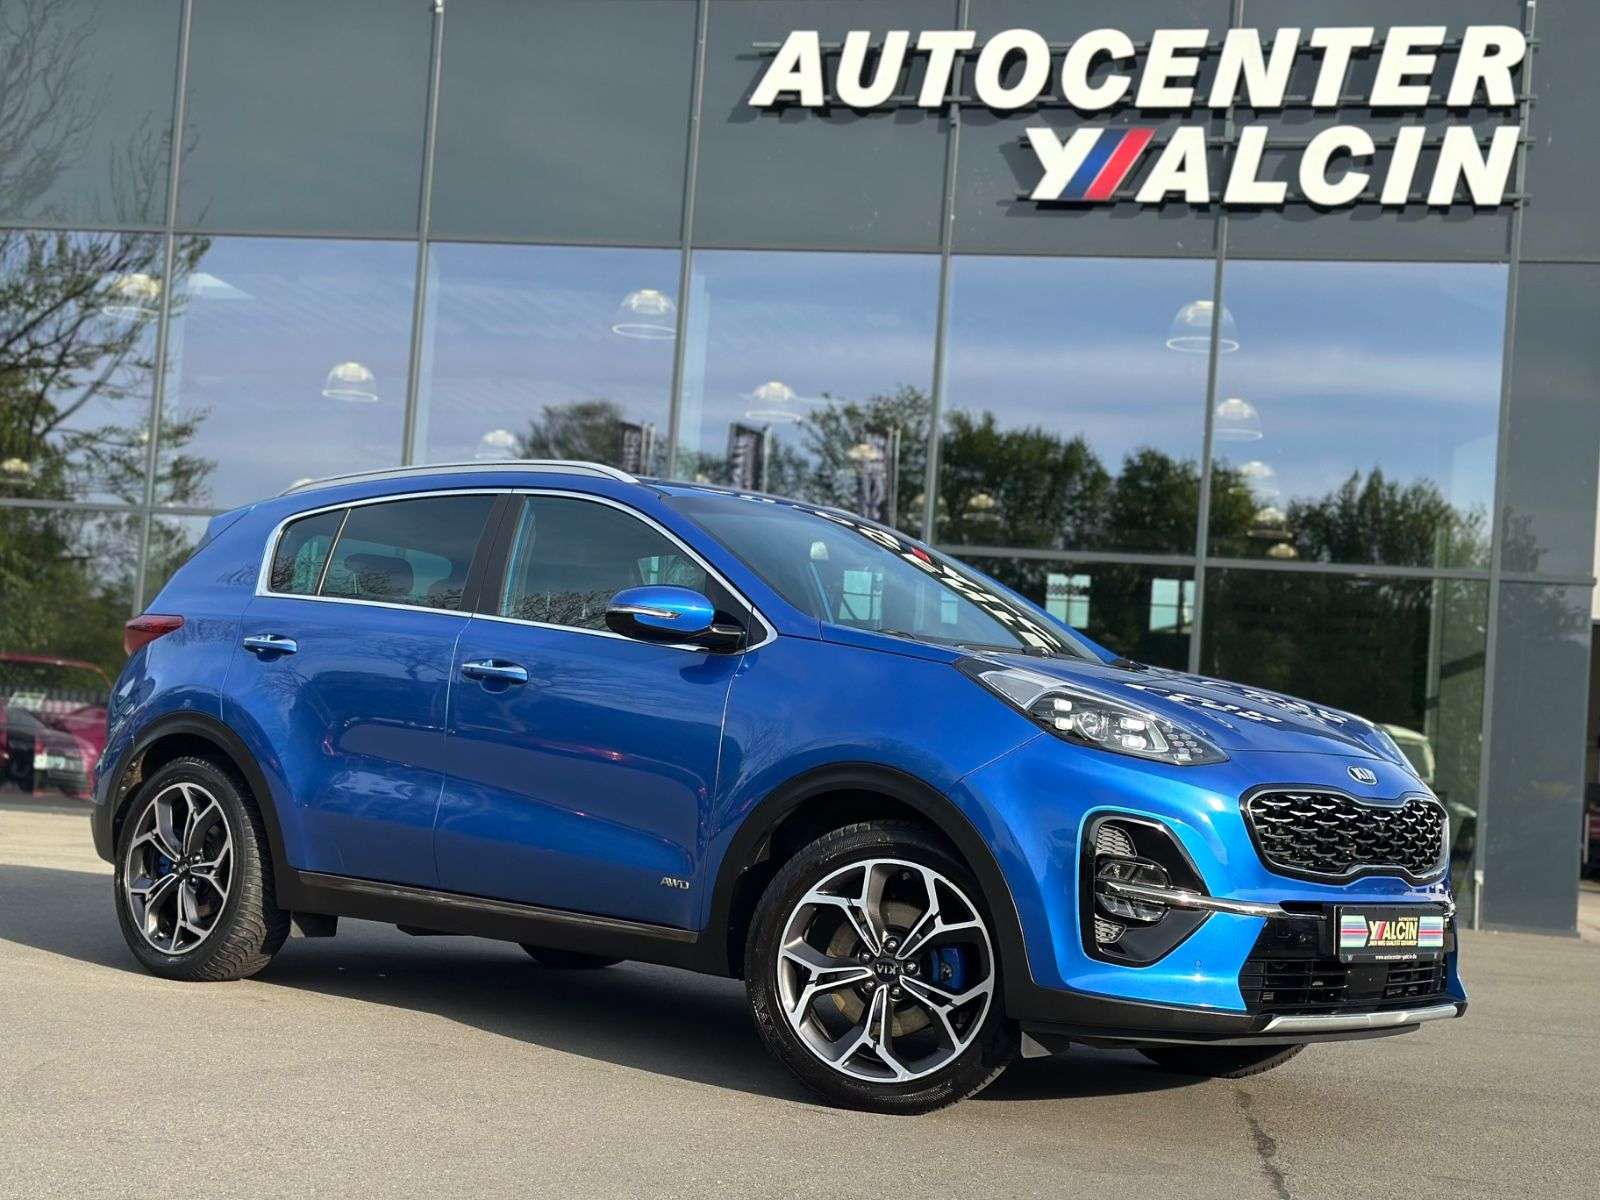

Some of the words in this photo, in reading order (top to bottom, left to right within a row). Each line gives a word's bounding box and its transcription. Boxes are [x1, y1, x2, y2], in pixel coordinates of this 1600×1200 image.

[748, 25, 1527, 111] AUTOCENTER
[1025, 125, 1521, 207] YALCIN
[660, 876, 689, 889] AWD
[1368, 920, 1418, 940] YALCIN
